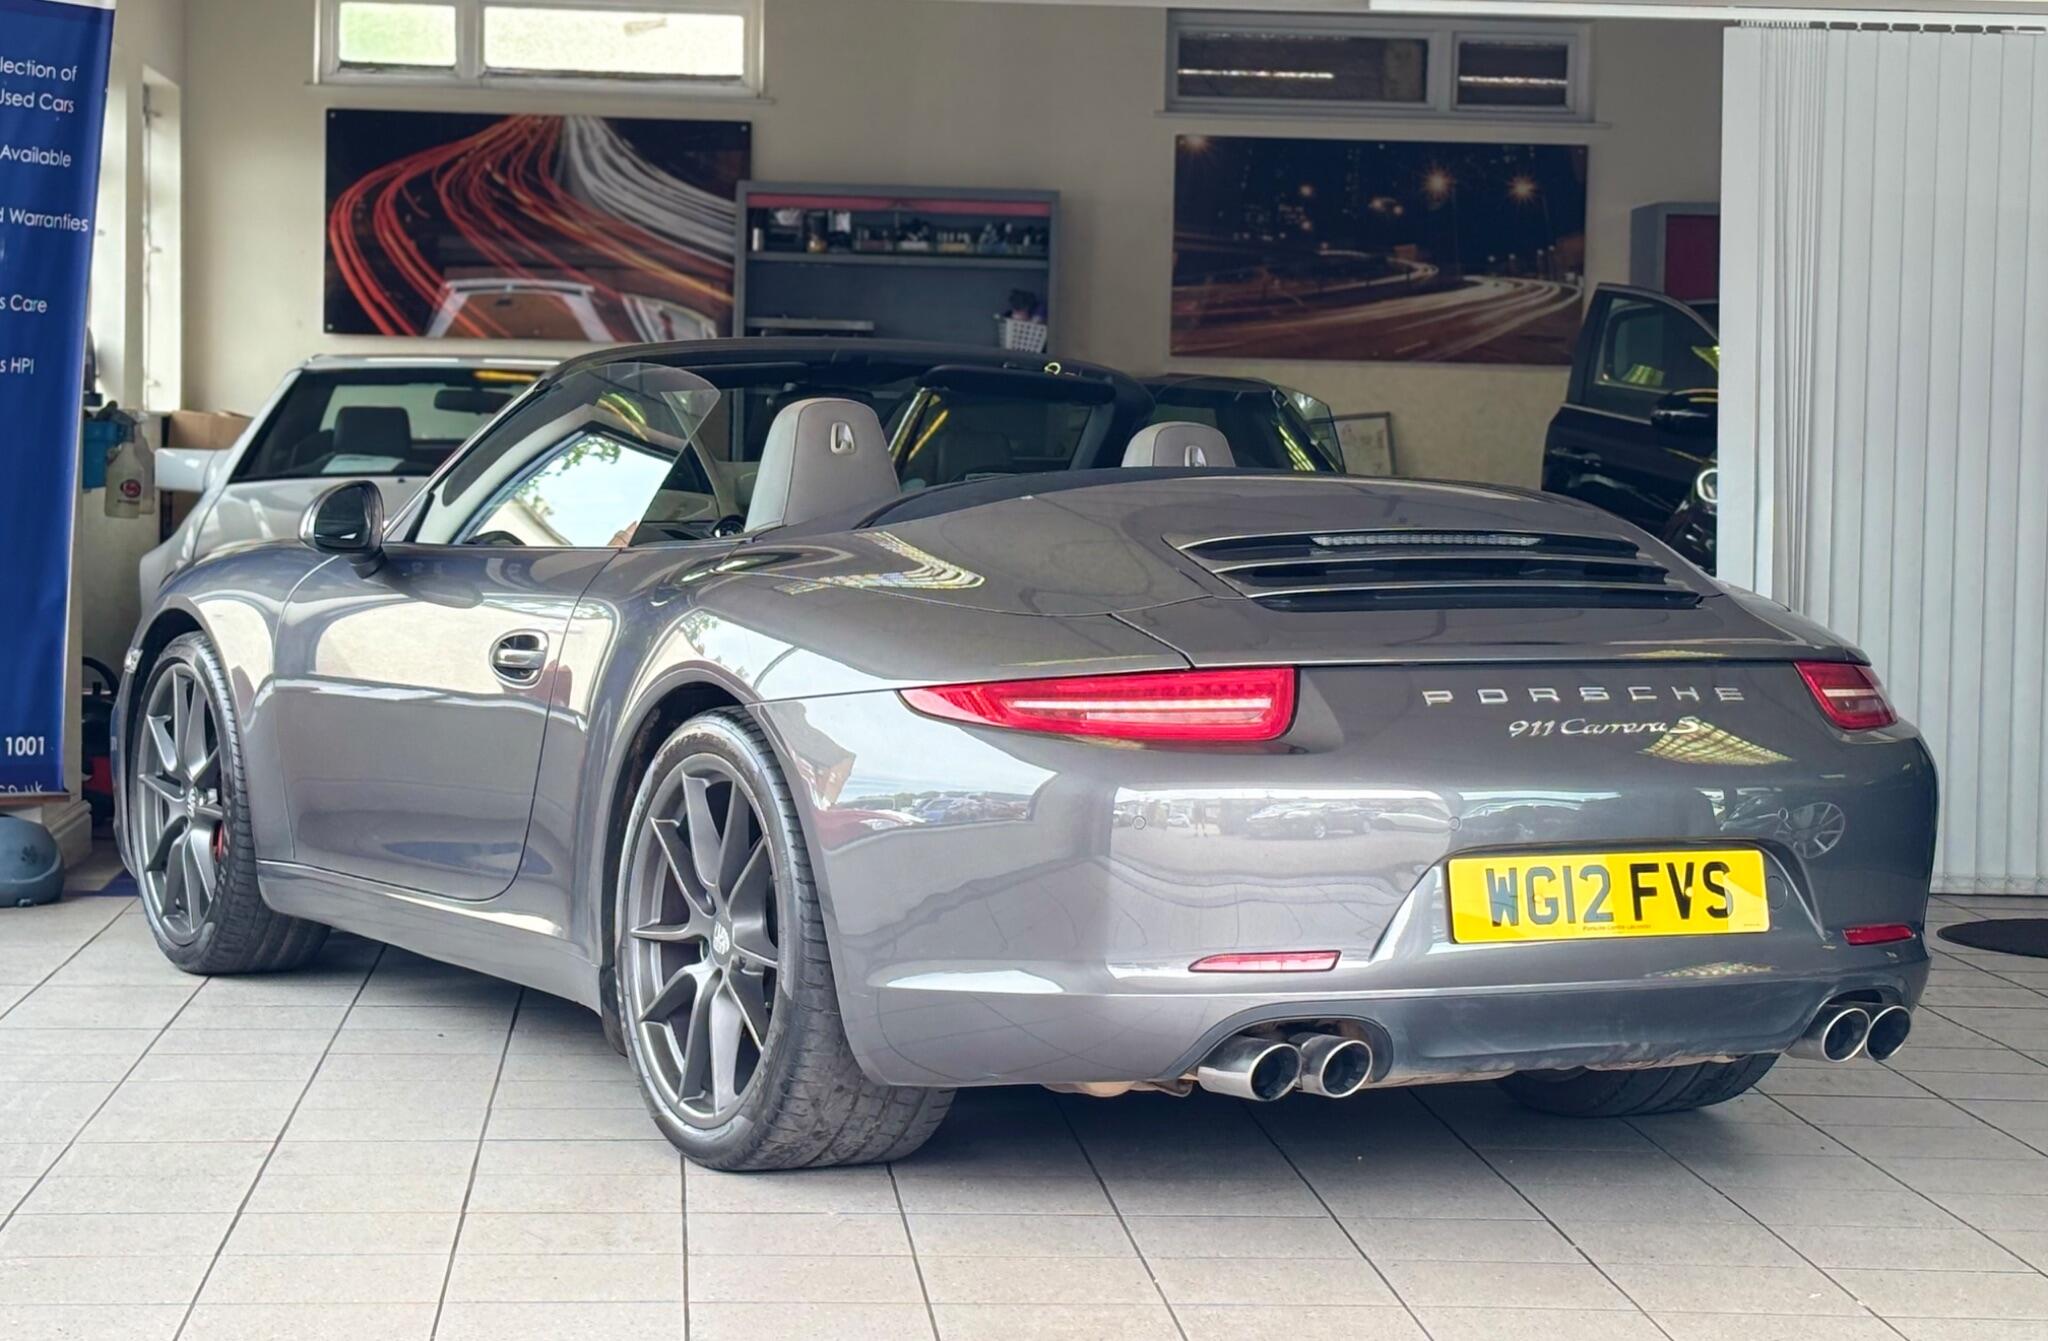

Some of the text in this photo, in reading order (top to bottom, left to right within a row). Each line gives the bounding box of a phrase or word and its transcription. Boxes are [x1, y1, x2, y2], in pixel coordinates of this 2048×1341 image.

[0, 56, 78, 82] lection of
[39, 92, 75, 113] Cars
[0, 144, 71, 168] Available
[9, 207, 89, 232] Warranties
[10, 294, 47, 313] Care
[10, 357, 34, 374] HPI
[1421, 686, 1745, 707] PORSCHE
[1508, 715, 1699, 738] 911 Carrera S
[5, 736, 45, 756] 1001
[1485, 860, 1734, 927] WG12 FVS
